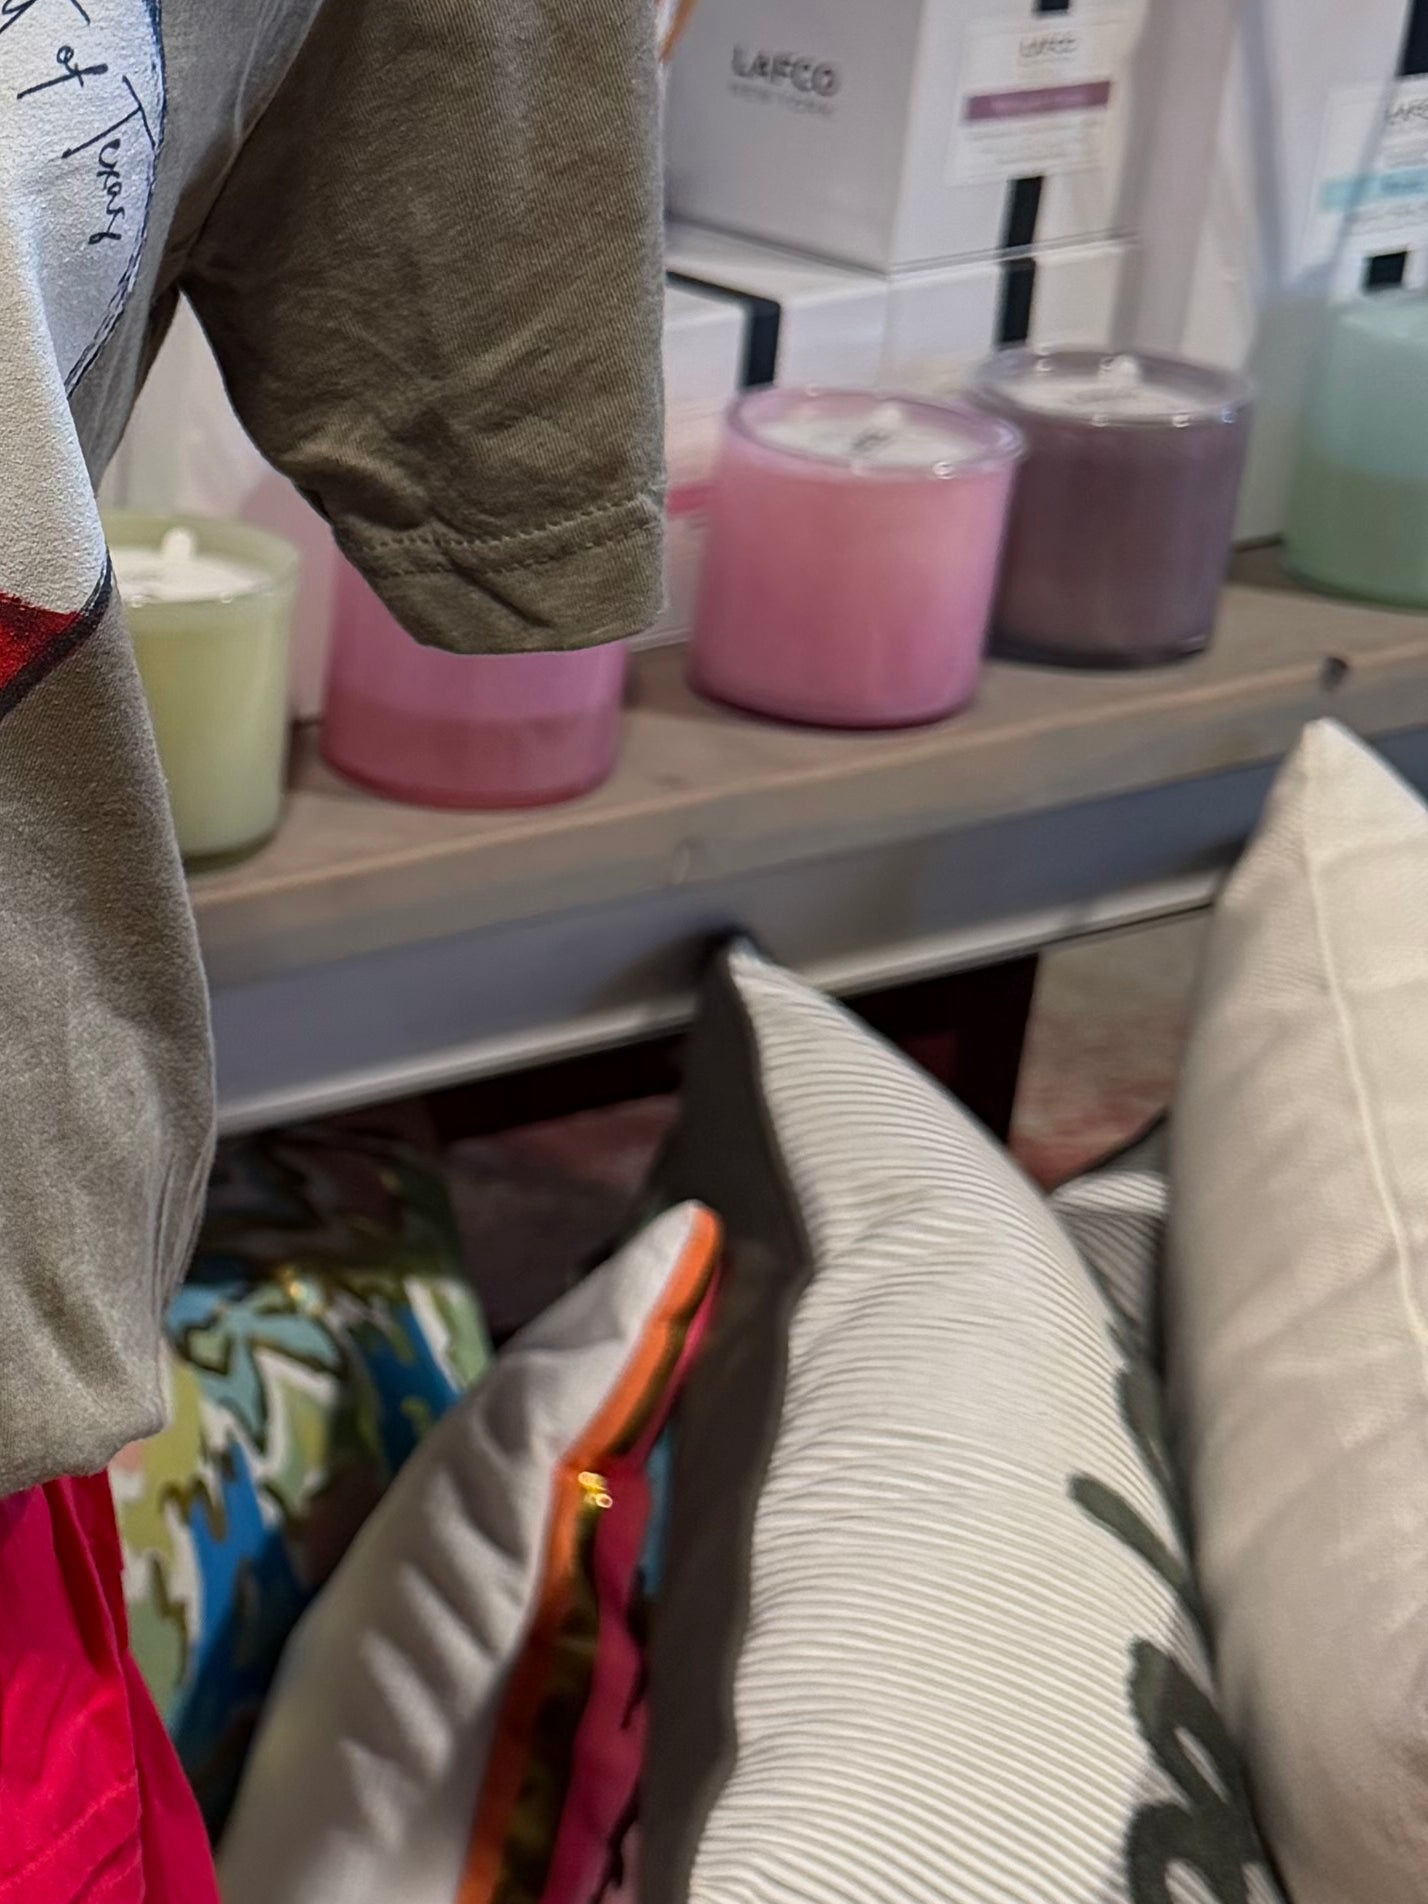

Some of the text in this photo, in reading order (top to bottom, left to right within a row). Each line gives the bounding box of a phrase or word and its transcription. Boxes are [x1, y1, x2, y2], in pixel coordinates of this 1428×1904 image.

[17, 44, 109, 100] of
[731, 43, 843, 98] LAFCO
[61, 74, 155, 246] Texas
